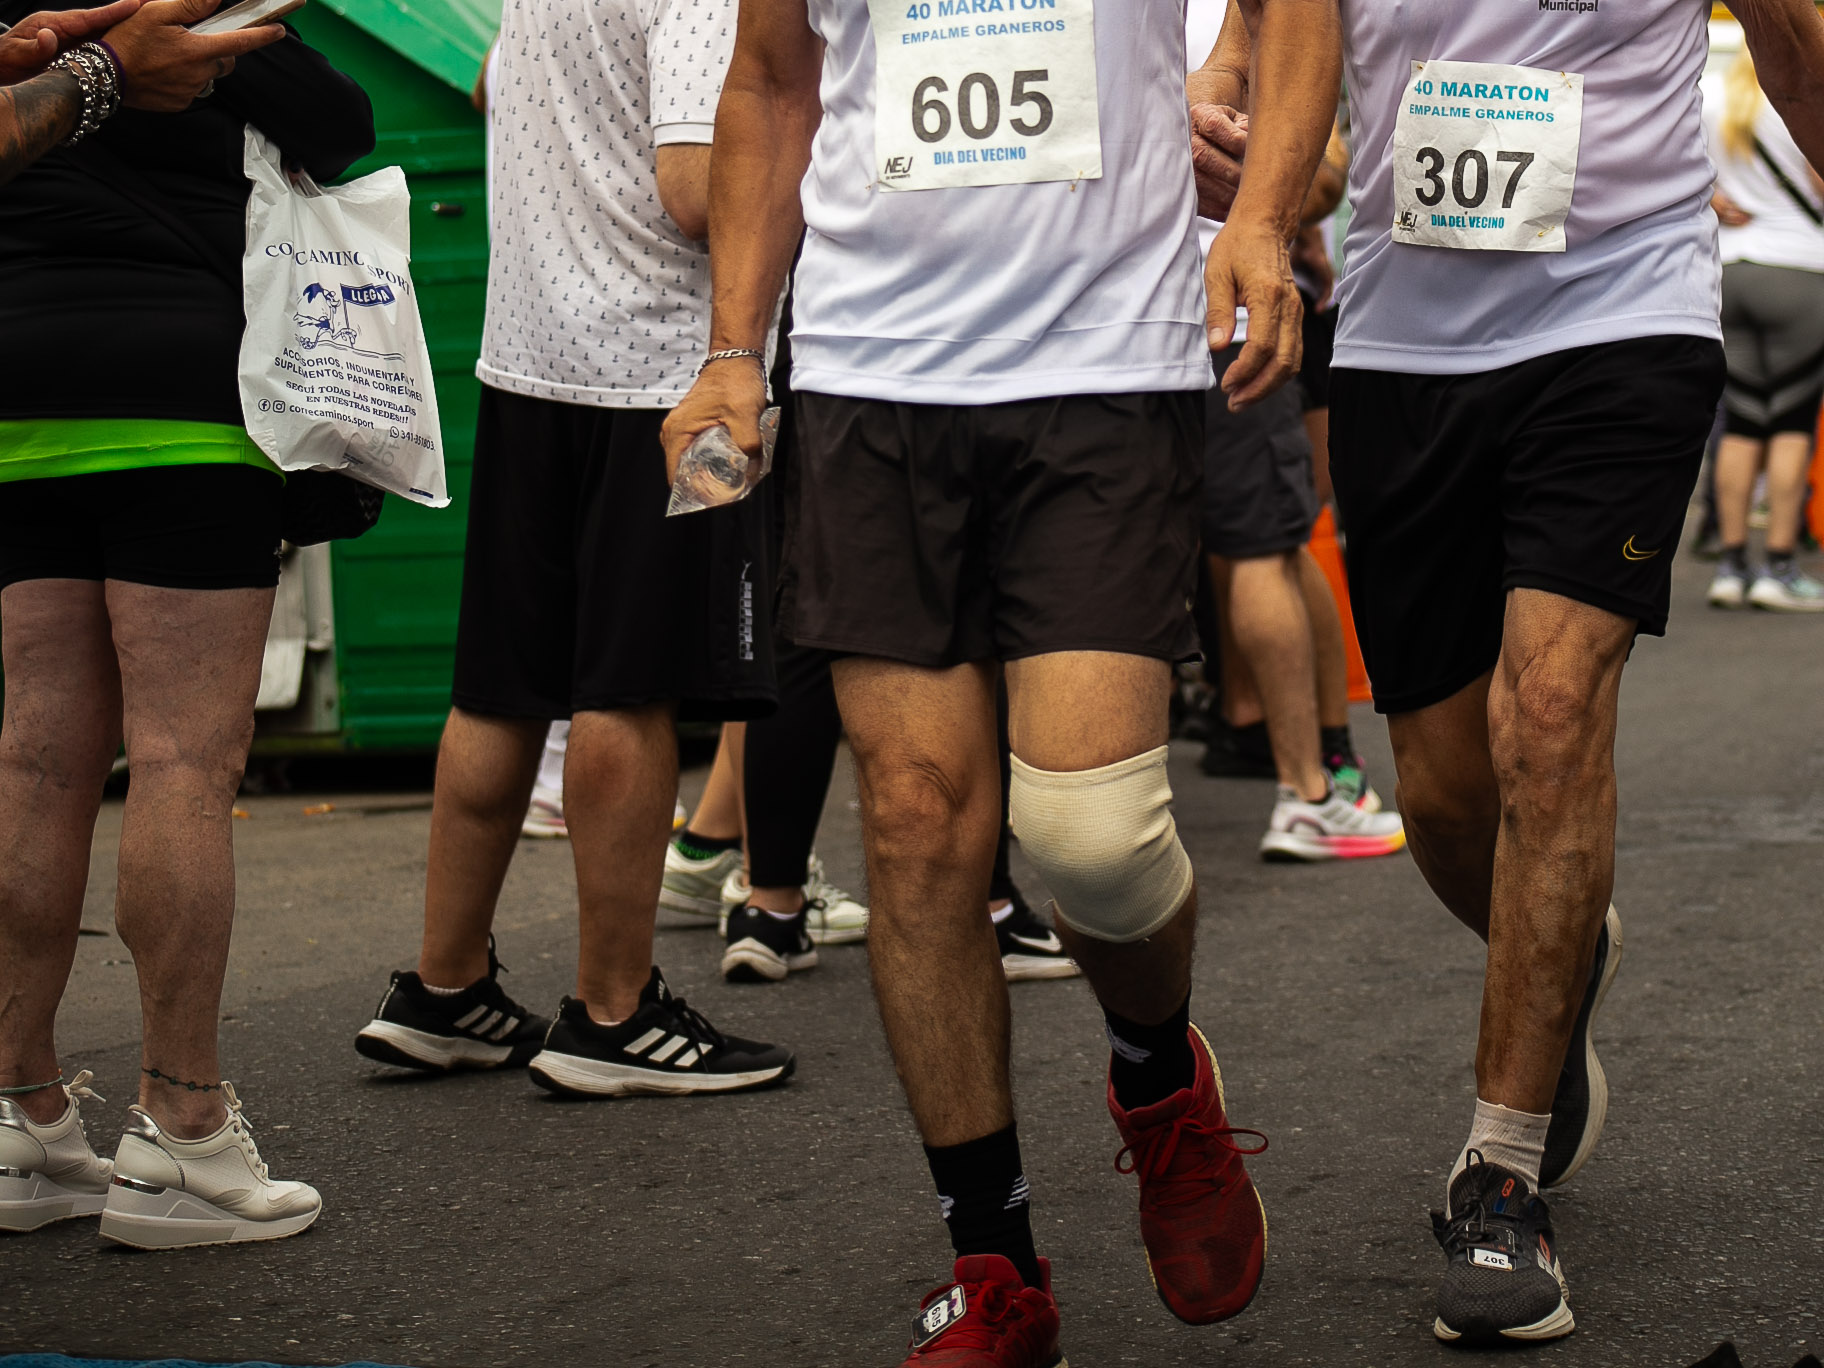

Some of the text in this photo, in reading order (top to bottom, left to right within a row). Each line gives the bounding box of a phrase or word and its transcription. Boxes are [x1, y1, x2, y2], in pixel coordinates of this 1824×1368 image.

[906, 3, 931, 21] 40
[1538, 0, 1599, 14] Municipal
[902, 20, 1066, 45] EMPALME GRANEROS
[1414, 80, 1549, 102] 40 MARATON
[911, 68, 1054, 143] 605
[1409, 103, 1555, 123] EMPALME GRANEROS
[884, 156, 913, 174] NEJ
[934, 146, 1027, 166] DIA DEL VECINO
[1415, 146, 1535, 209] 307
[1431, 213, 1505, 229] DIA DEL VECINO
[366, 264, 411, 296] SPORT
[283, 347, 344, 370] ACCSORIOS,
[347, 373, 371, 387] PARA
[318, 385, 351, 397] TODAS
[353, 391, 369, 403] LAS
[306, 395, 409, 424] EN NUESTRAS REDES!!!
[1483, 1255, 1506, 1266] 307
